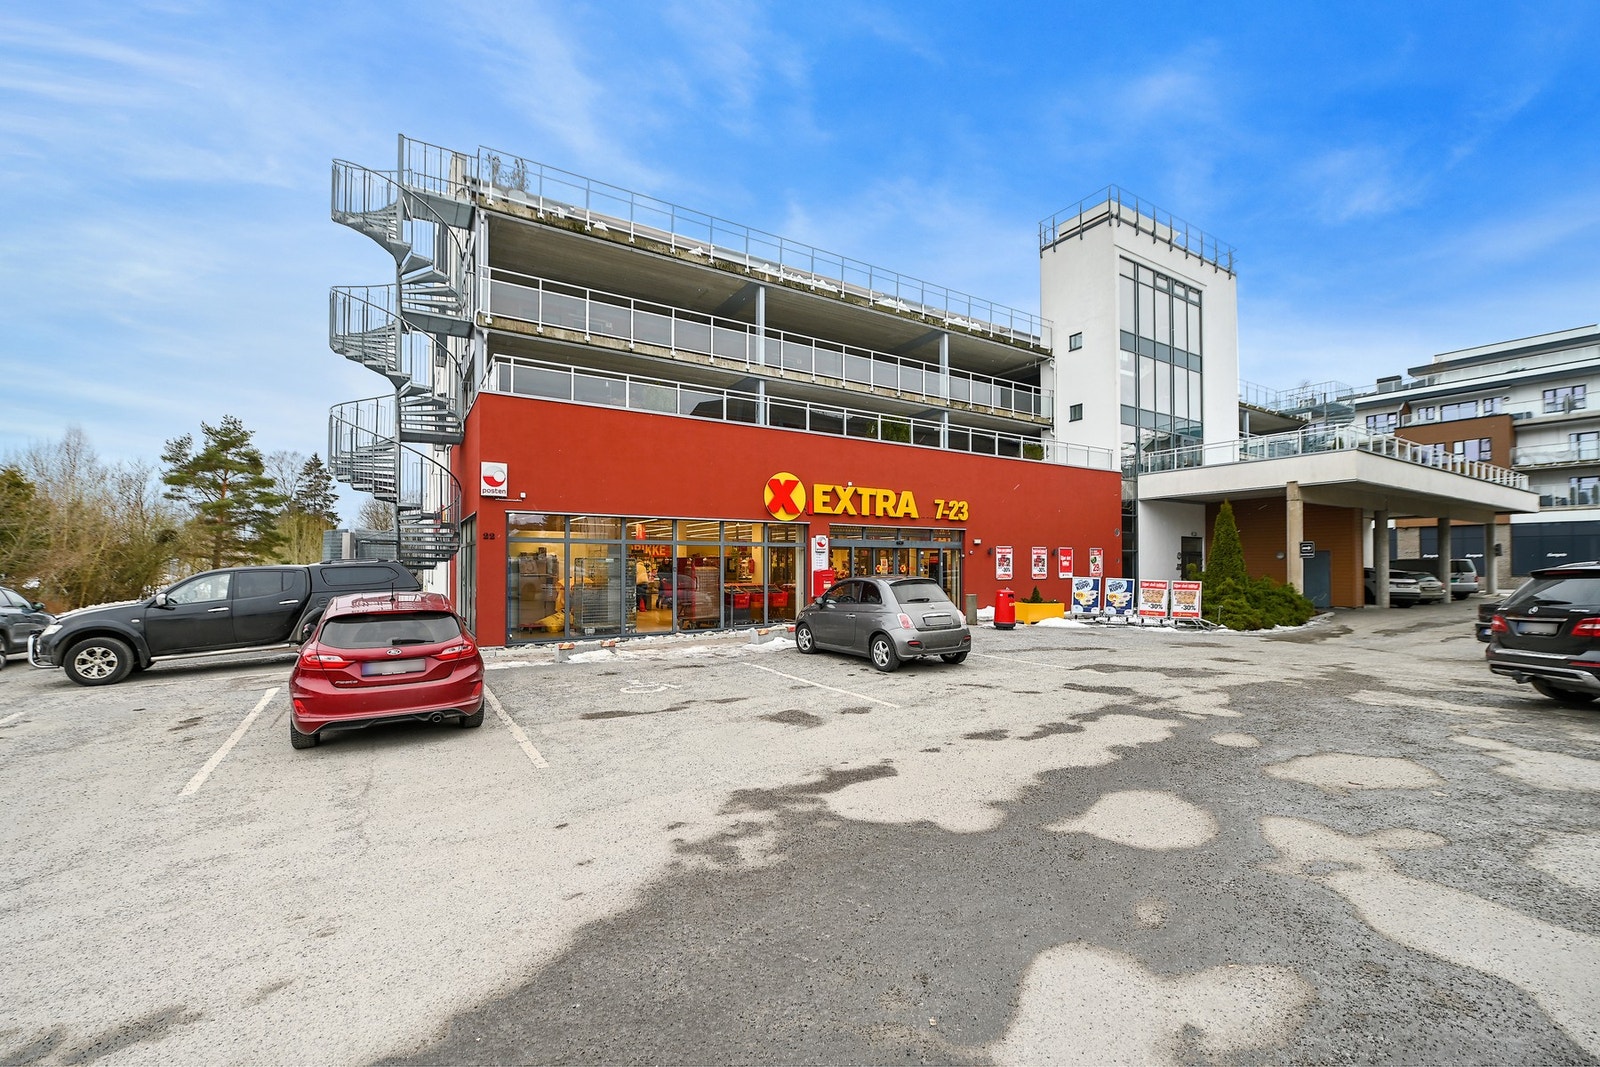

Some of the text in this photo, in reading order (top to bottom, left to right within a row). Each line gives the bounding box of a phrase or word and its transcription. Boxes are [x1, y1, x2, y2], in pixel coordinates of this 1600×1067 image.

[813, 483, 919, 519] EXTRA
[934, 499, 969, 521] 7-23
[482, 532, 495, 540] 22
